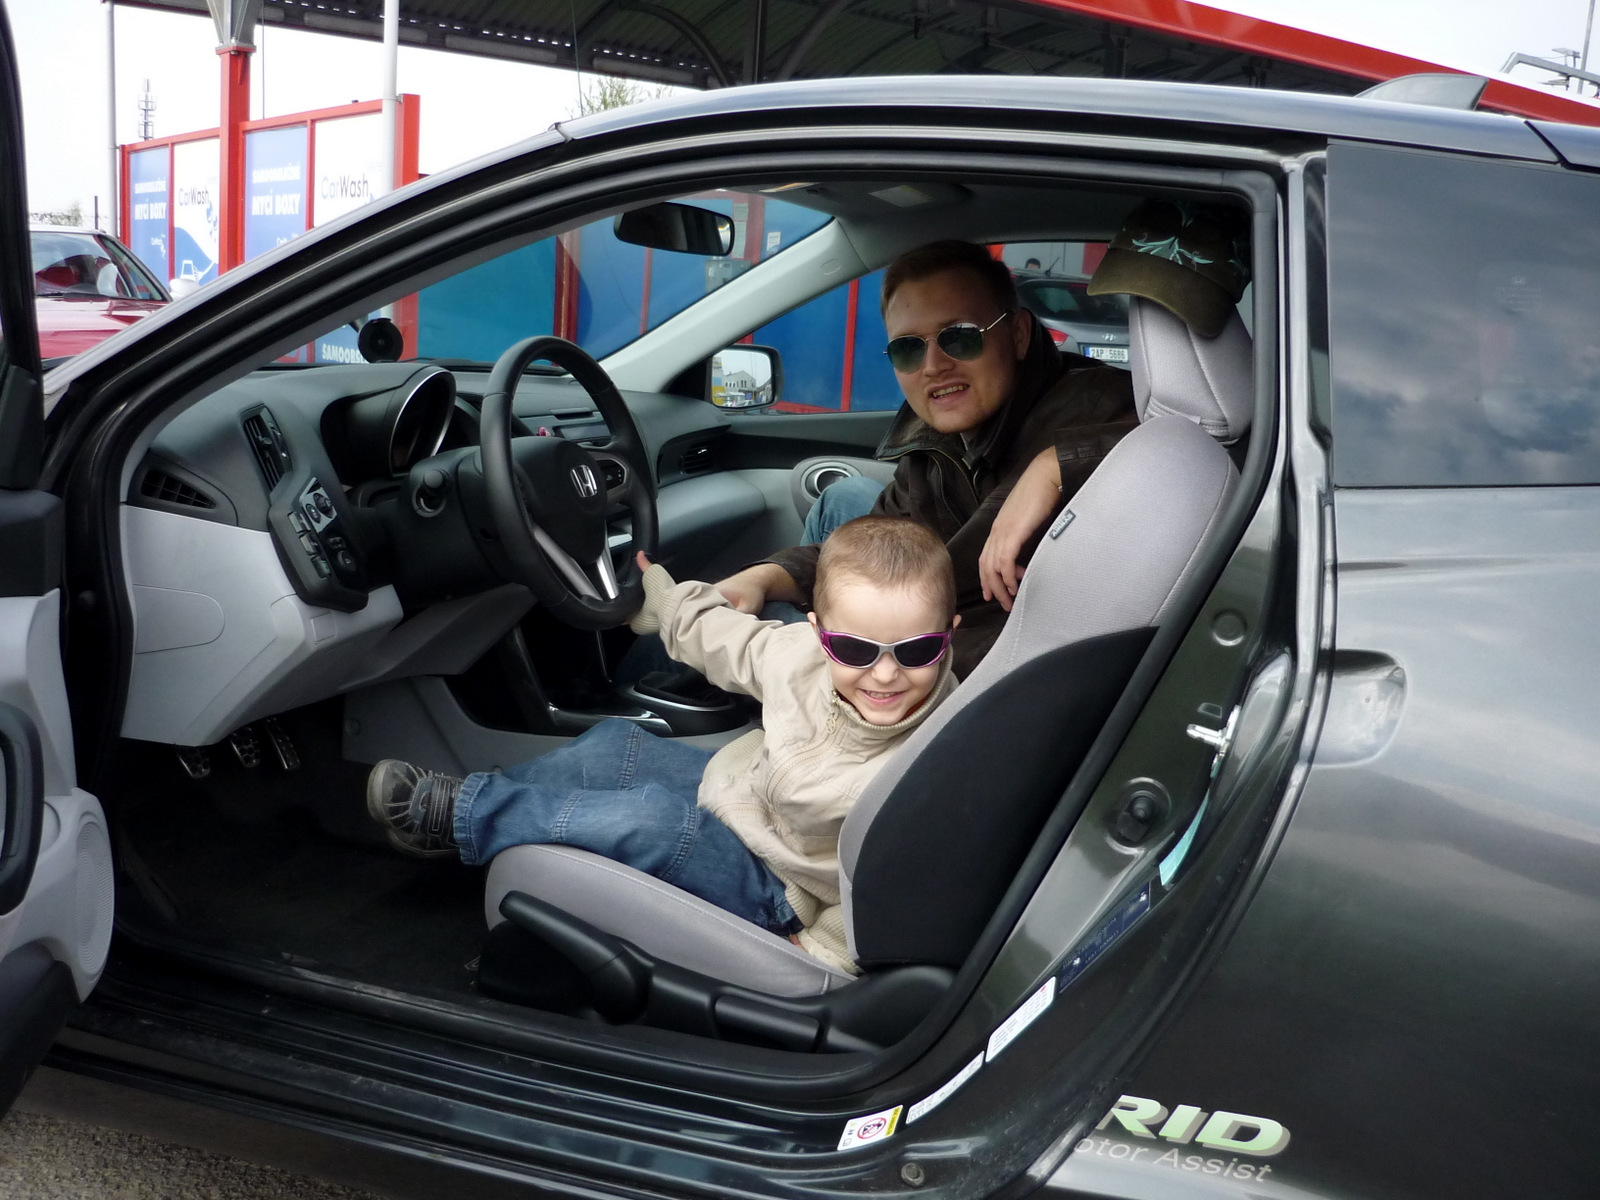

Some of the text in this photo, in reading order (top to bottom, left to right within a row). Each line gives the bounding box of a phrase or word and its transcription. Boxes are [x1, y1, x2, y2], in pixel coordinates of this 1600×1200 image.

[179, 186, 209, 206] CarWash
[321, 173, 369, 200] CarWash
[274, 193, 301, 216] BOXY
[322, 343, 369, 364] SAMOOBSL
[1152, 1148, 1272, 1182] Assist
